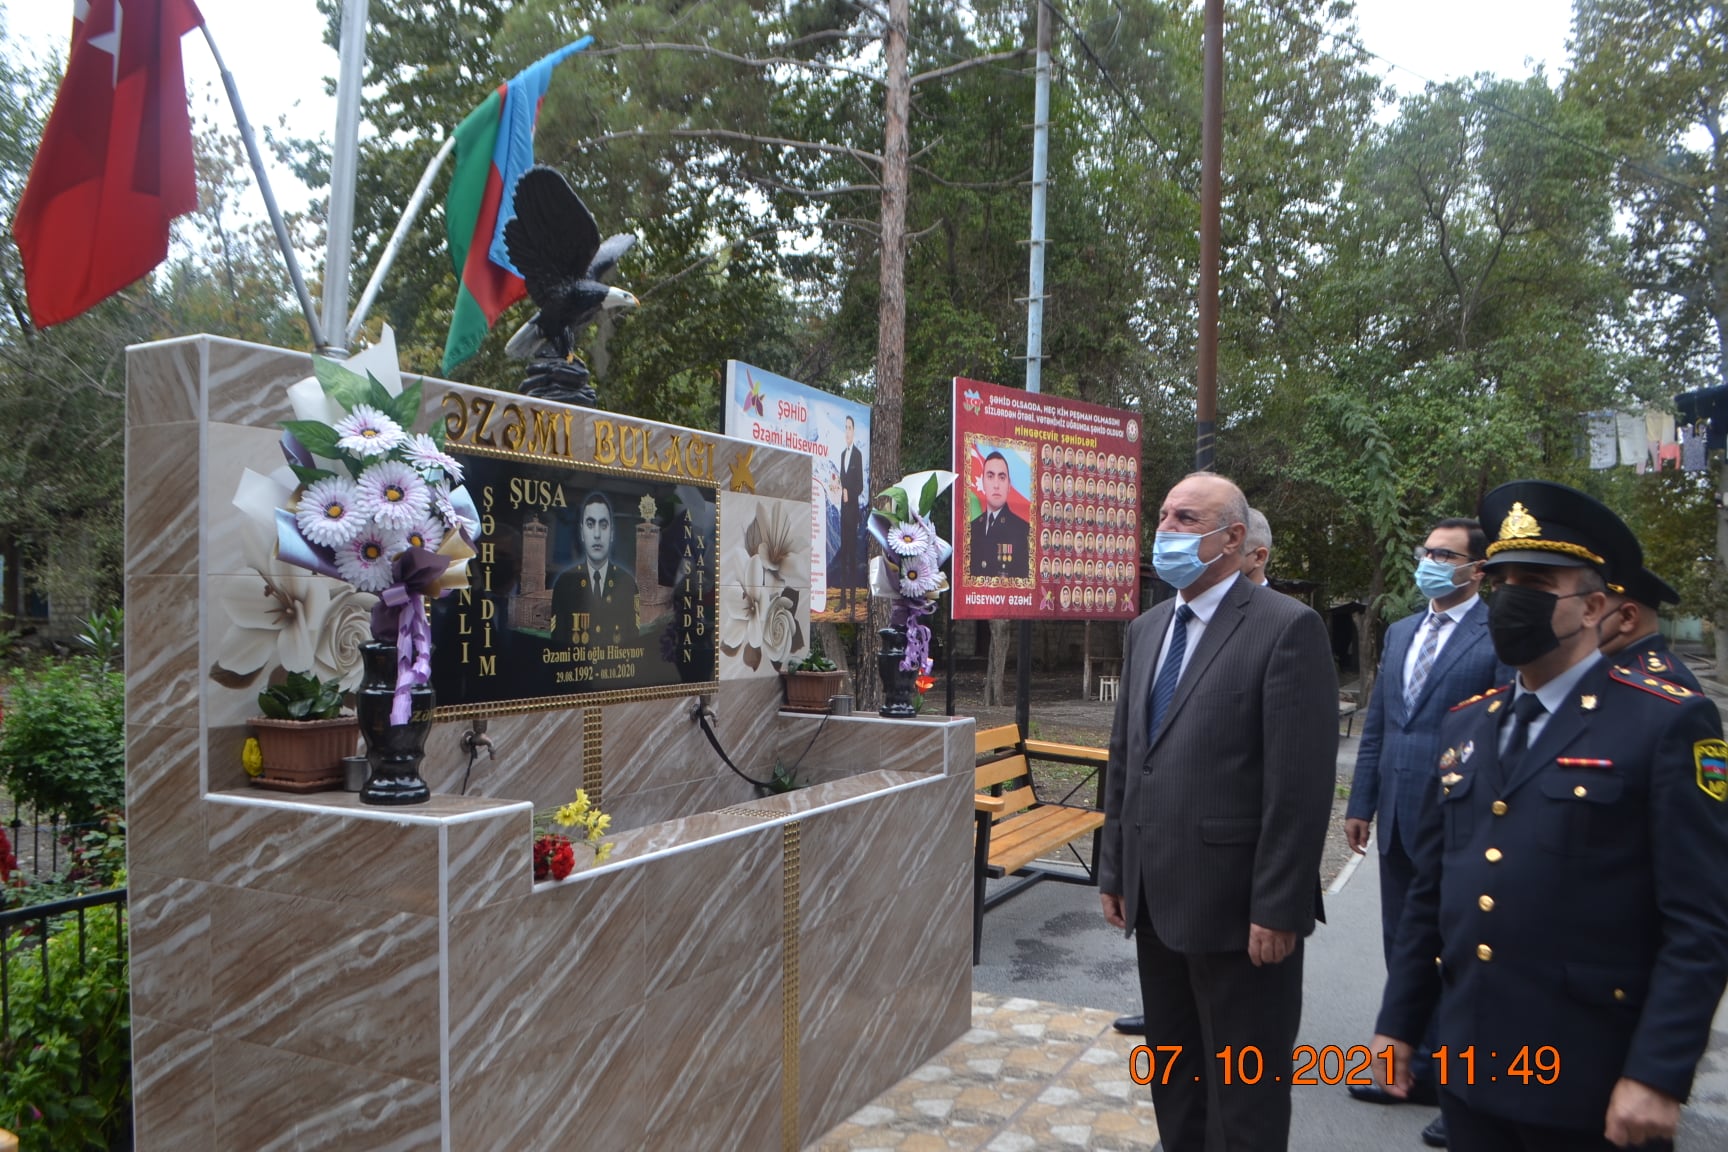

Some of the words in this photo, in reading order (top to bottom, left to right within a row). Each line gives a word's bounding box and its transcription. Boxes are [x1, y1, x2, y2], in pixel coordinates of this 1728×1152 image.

[778, 400, 807, 422] ŞƏHİD
[989, 394, 1011, 407] ŞƏHİD
[441, 391, 574, 458] ƏZƏMİ
[593, 419, 717, 481] BULAĞI
[752, 422, 783, 446] Əzəmi
[510, 477, 568, 512] ŞUŞA
[478, 485, 497, 677] ŞƏHİDİM
[965, 591, 1006, 606] HÜSEYNOV
[1008, 596, 1032, 606] ƏZƏMİ
[542, 647, 571, 664] Əzəmi
[572, 646, 586, 662] Əli
[587, 645, 605, 665] oğlu
[607, 645, 645, 662] Hüseynov
